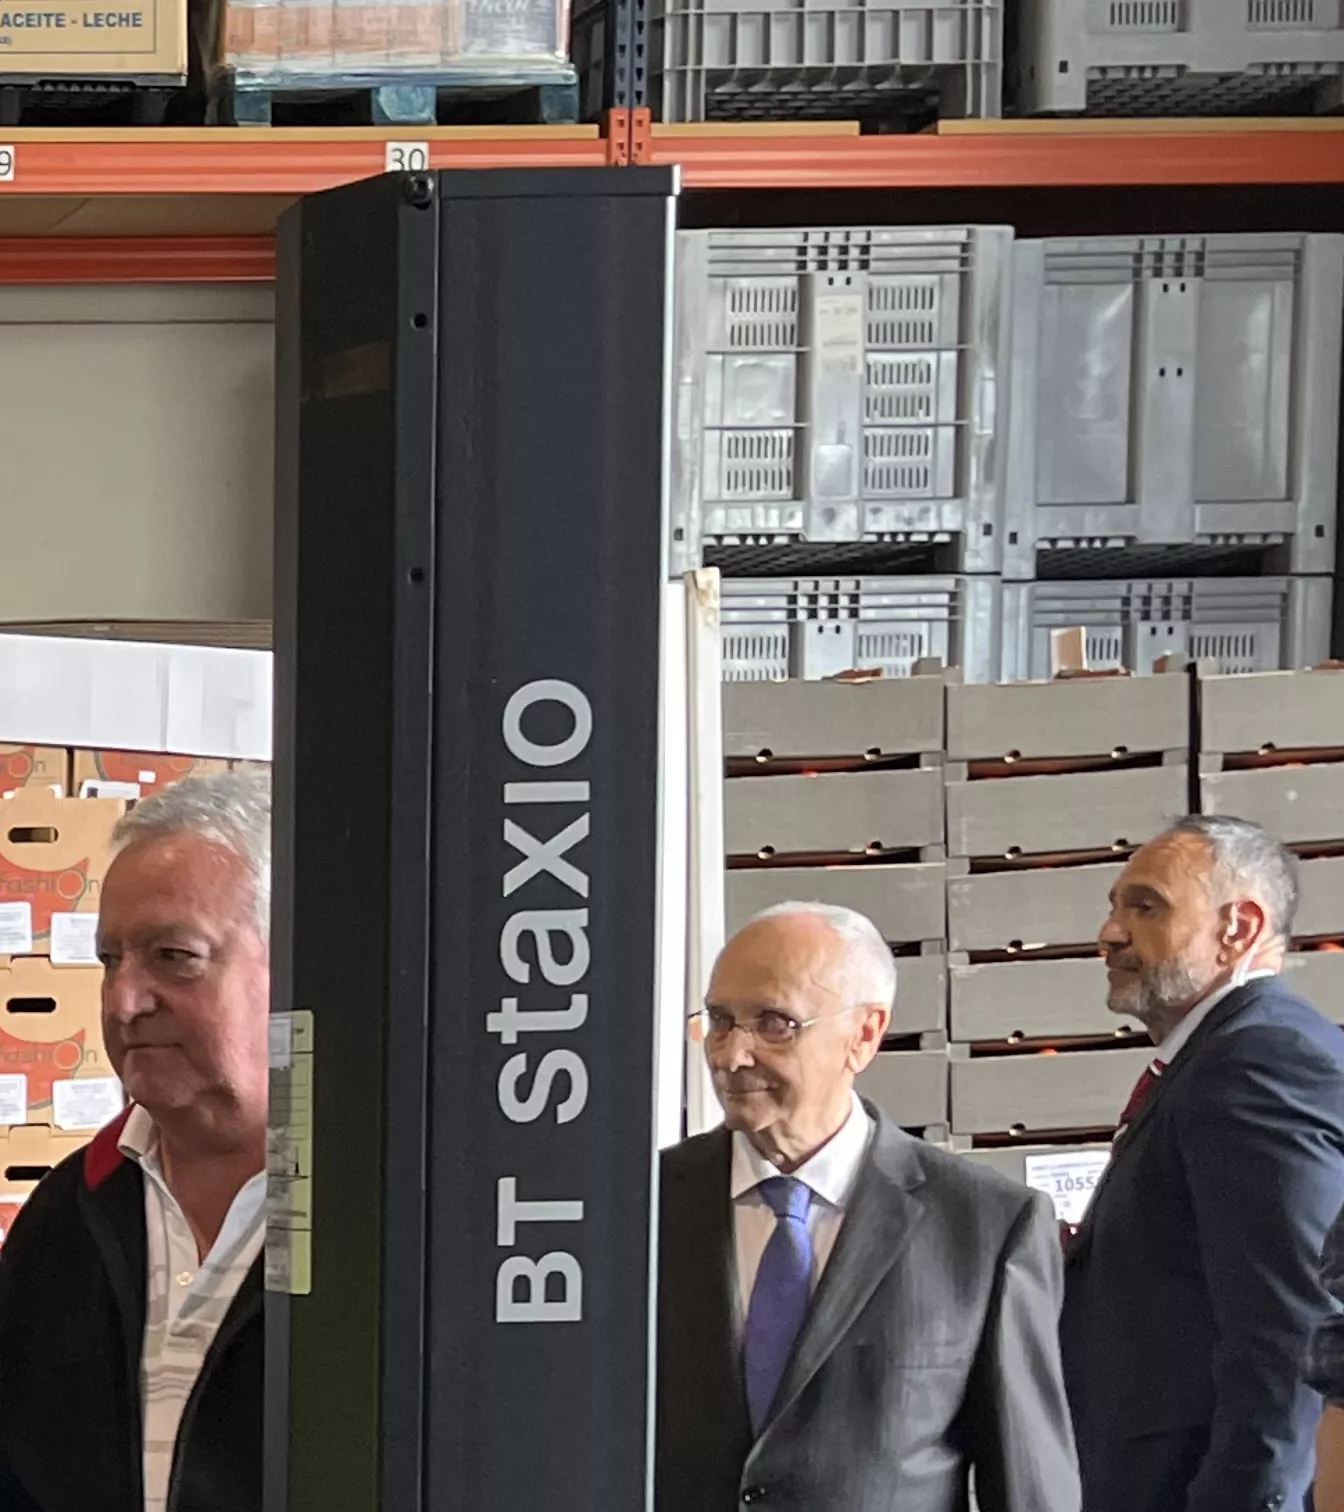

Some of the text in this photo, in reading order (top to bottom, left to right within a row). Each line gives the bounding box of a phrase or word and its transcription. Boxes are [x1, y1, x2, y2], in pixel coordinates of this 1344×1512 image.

[0, 12, 66, 28] ACEITE
[83, 12, 143, 28] LECHE
[390, 147, 425, 170] 30
[1055, 1174, 1100, 1193] 1055
[495, 1176, 584, 1324] BT
